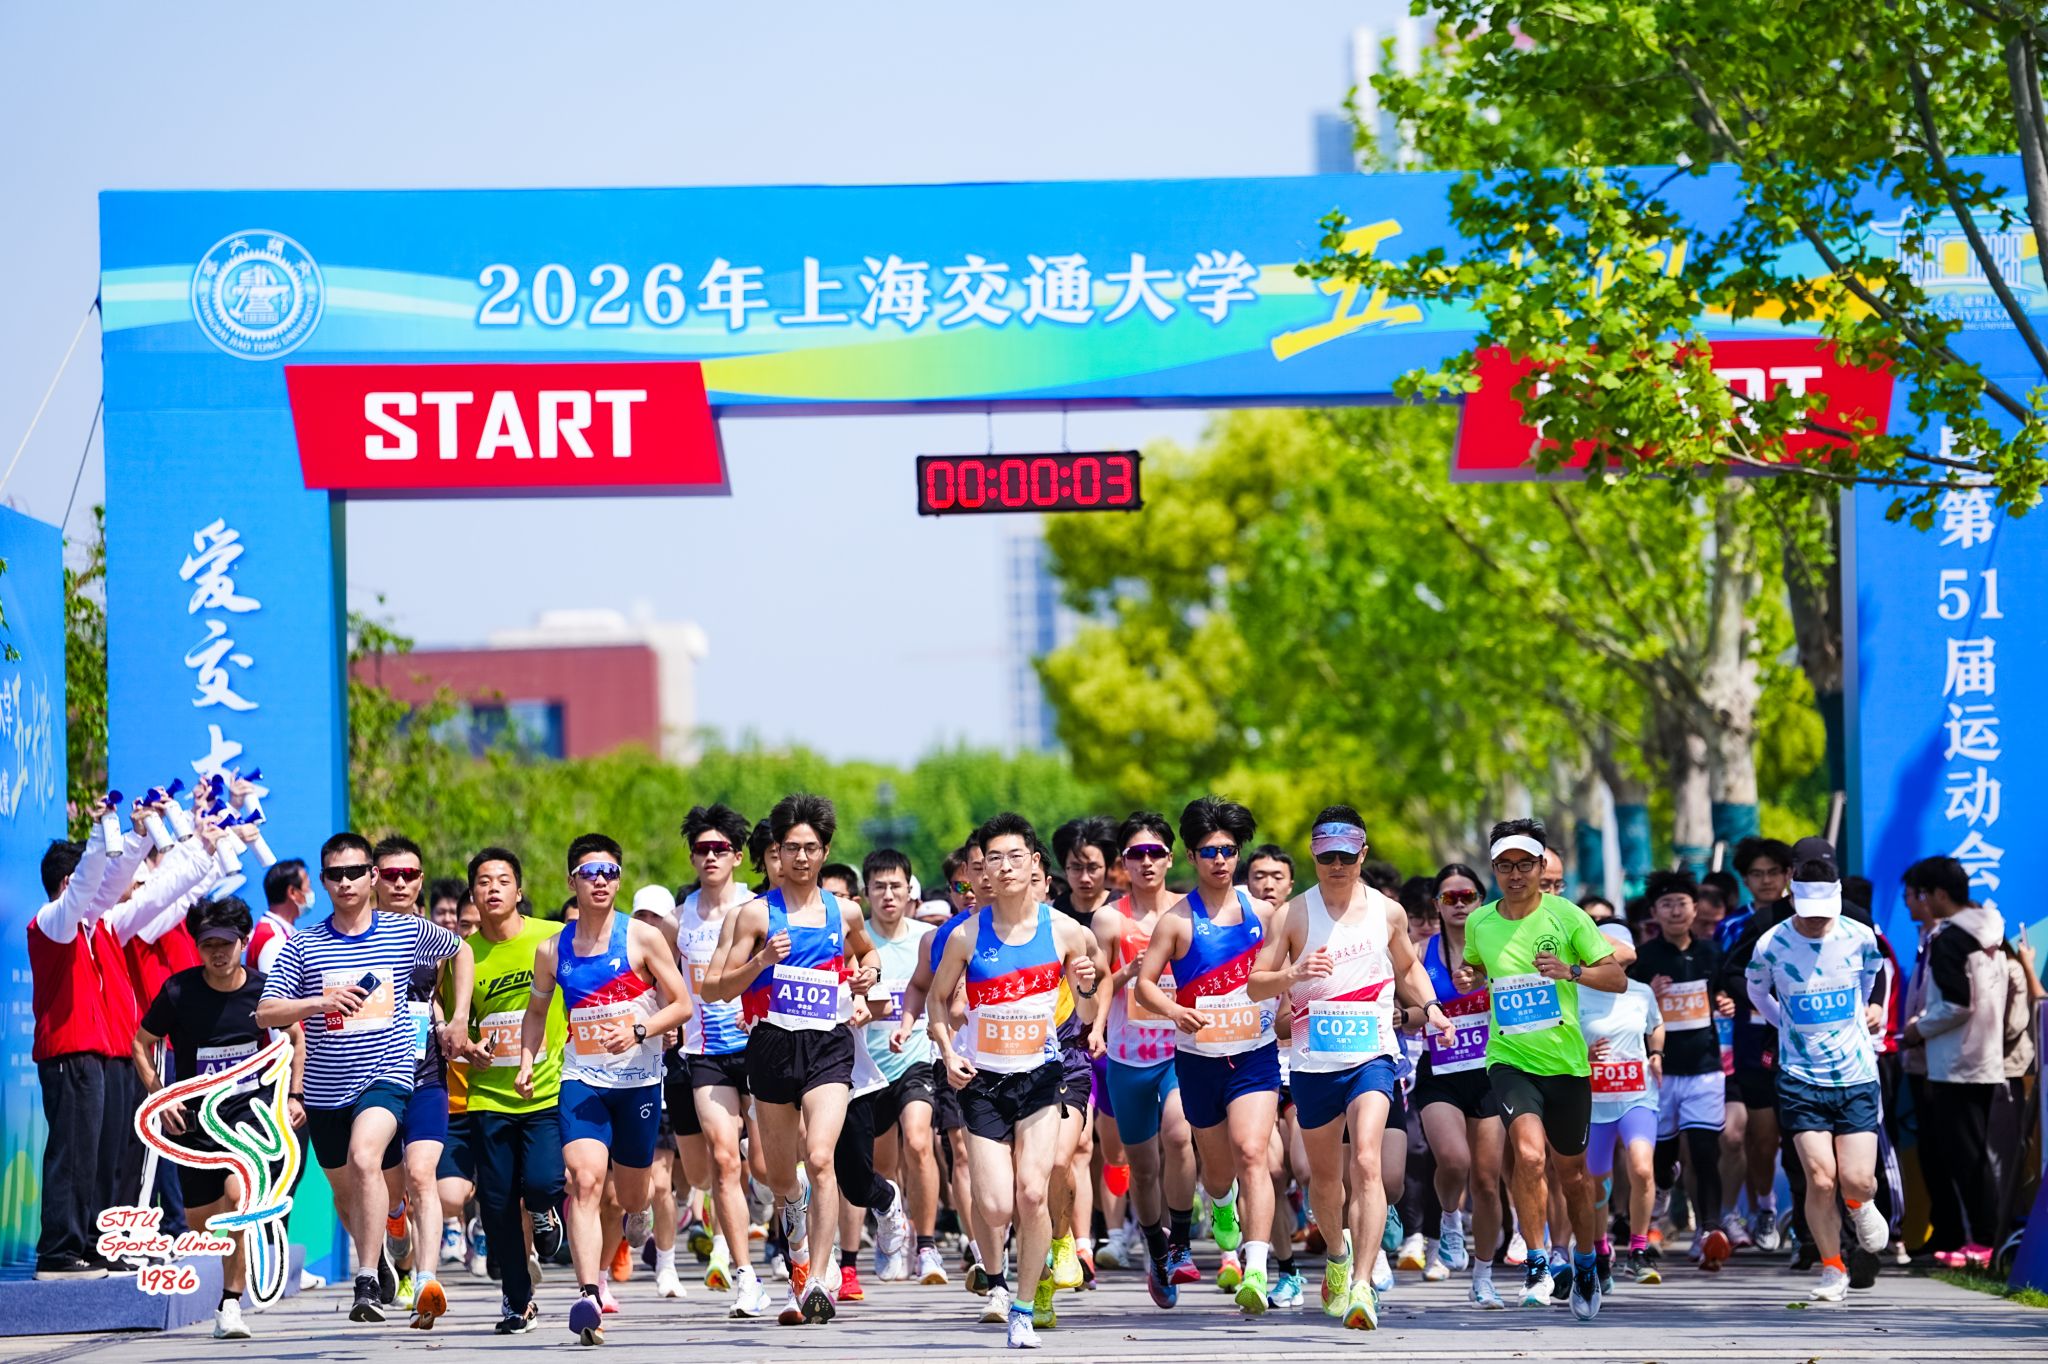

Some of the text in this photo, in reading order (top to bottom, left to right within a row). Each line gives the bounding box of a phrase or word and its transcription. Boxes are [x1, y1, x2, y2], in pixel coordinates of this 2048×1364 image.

[478, 250, 1257, 330] 2026年上海交通大学
[364, 389, 647, 461] START
[926, 456, 1133, 510] 00:00:03
[777, 984, 831, 1006] A102
[974, 970, 1056, 1007] 上海交通大学
[1498, 989, 1551, 1011] C012
[1798, 993, 1848, 1012] C010
[326, 1016, 342, 1026] 555
[985, 1023, 1040, 1041] B189
[1316, 1019, 1370, 1036] C023
[1593, 1065, 1638, 1081] F018
